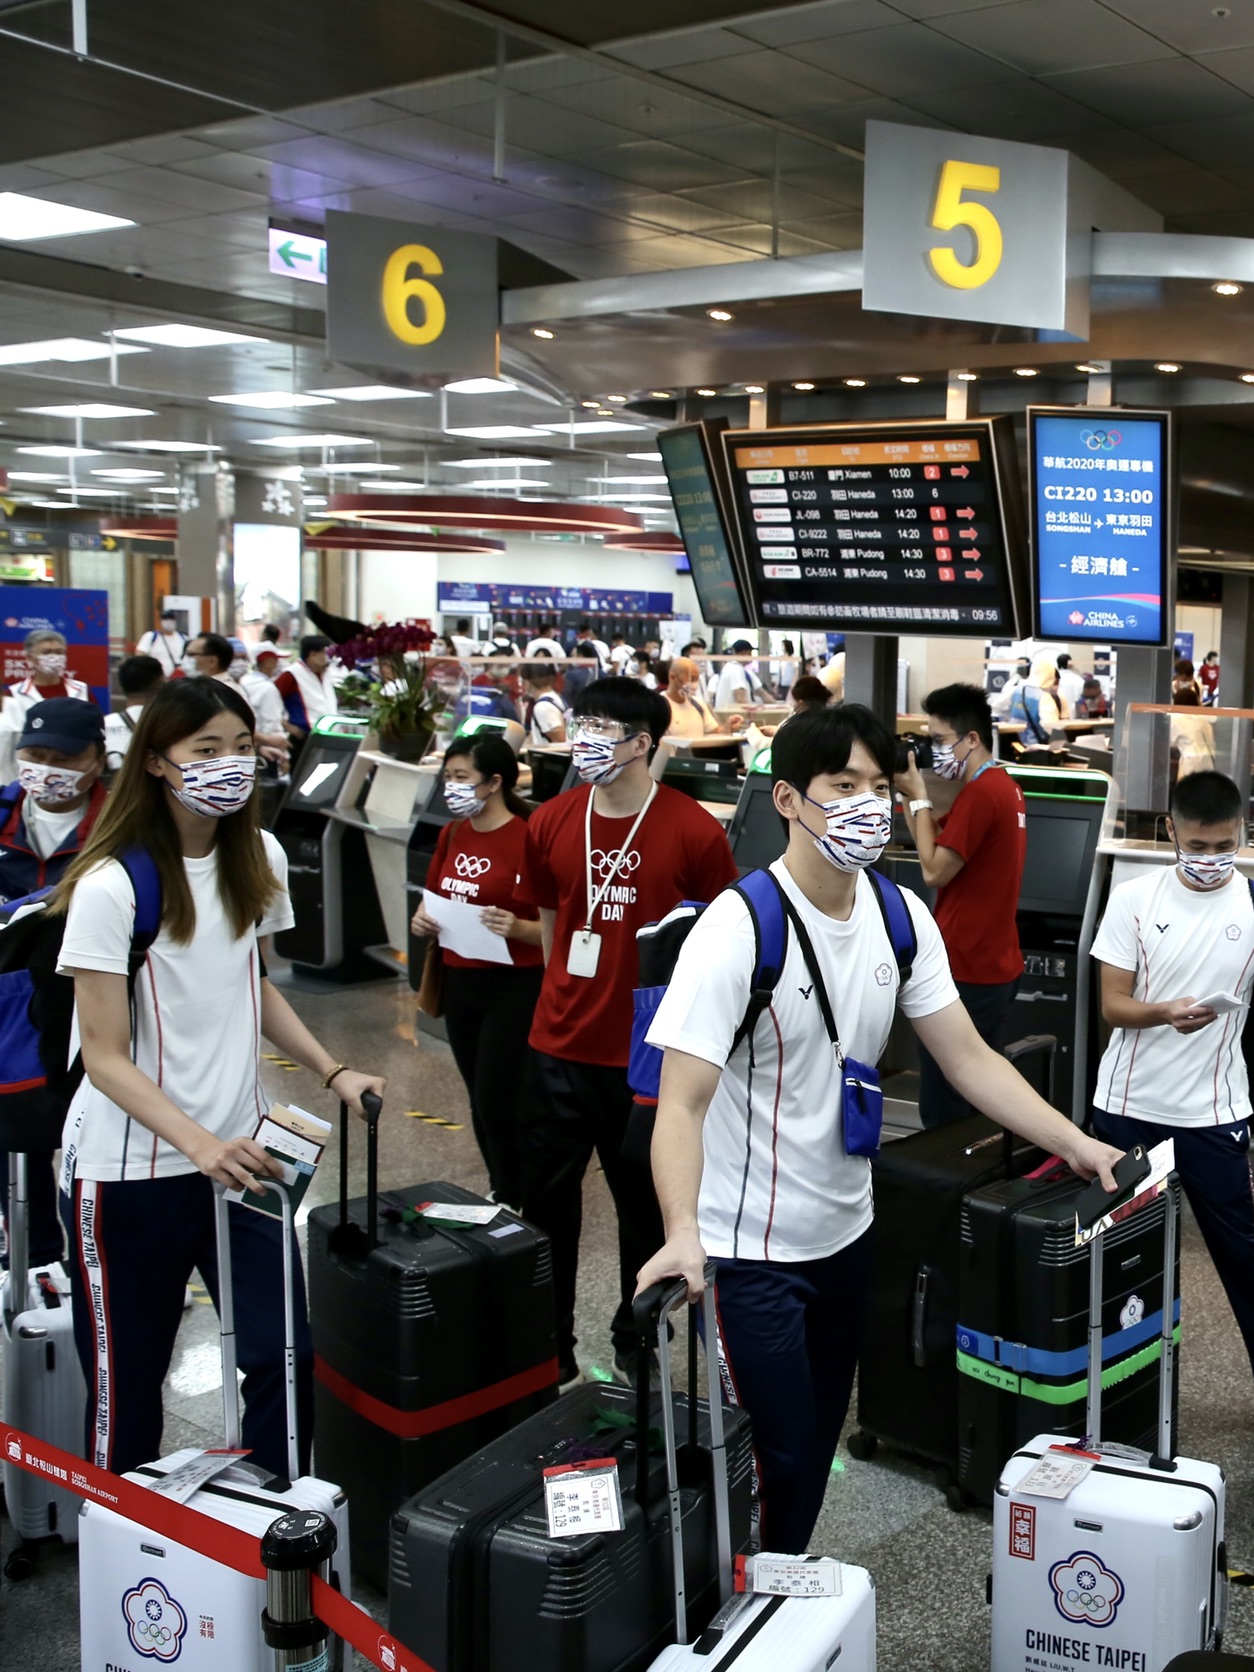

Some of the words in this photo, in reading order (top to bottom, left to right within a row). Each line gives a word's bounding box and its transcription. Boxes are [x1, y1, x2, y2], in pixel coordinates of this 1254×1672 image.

[928, 159, 1004, 290] 5
[381, 243, 446, 346] 6
[1043, 456, 1154, 473] 華航2020年奧運專機
[789, 471, 814, 481] B7-511
[845, 470, 872, 480] Xiamen
[888, 468, 911, 478] 10:00
[929, 467, 936, 478] 2
[791, 490, 817, 500] CI-220
[831, 489, 847, 501] 羽田
[847, 489, 875, 500] Haneda
[891, 488, 914, 499] 13:00
[932, 488, 939, 498] 6
[1044, 485, 1097, 501] CI220
[1103, 488, 1153, 504] 13:00
[795, 509, 821, 520] JL-098
[834, 509, 850, 520] 羽田
[850, 509, 878, 519] Haneda
[894, 508, 917, 519] 14:20
[935, 508, 940, 517] 1
[1045, 511, 1092, 525] 台北松山
[1106, 514, 1153, 527] 東京羽田
[837, 529, 853, 540] 羽田
[853, 529, 882, 539] Haneda
[897, 529, 920, 539] 14:20
[938, 529, 943, 538] 1
[1046, 524, 1091, 534] SONGSHAN
[1113, 527, 1147, 536] HANEDA
[802, 549, 830, 558] BR-772
[857, 549, 885, 561] Pudong
[901, 549, 923, 559] 14:30
[941, 550, 947, 559] 3
[805, 567, 837, 577] CA-5514
[860, 568, 888, 580] Pudong
[904, 569, 926, 579] 14:30
[943, 570, 950, 579] 3
[972, 609, 998, 621] 09:56
[1088, 611, 1119, 620] CHINA
[1083, 619, 1125, 628] AIRLINES
[441, 876, 480, 898] OLYMPIC
[81, 1198, 94, 1240] CHINESE
[83, 1241, 100, 1268] TAIPEI
[717, 1357, 737, 1401] CHINESE
[25, 1453, 68, 1480] 臺北松山機場
[71, 1471, 87, 1483] TAIPEI
[71, 1478, 97, 1494] SONGSHAN
[97, 1489, 118, 1503] AIRPORT
[750, 1502, 761, 1524] IPEI
[1014, 1520, 1031, 1555] 幸福
[773, 1579, 820, 1587] 李泰相
[1025, 1628, 1091, 1663] CHINESE
[1095, 1644, 1147, 1672] TAIPEI
